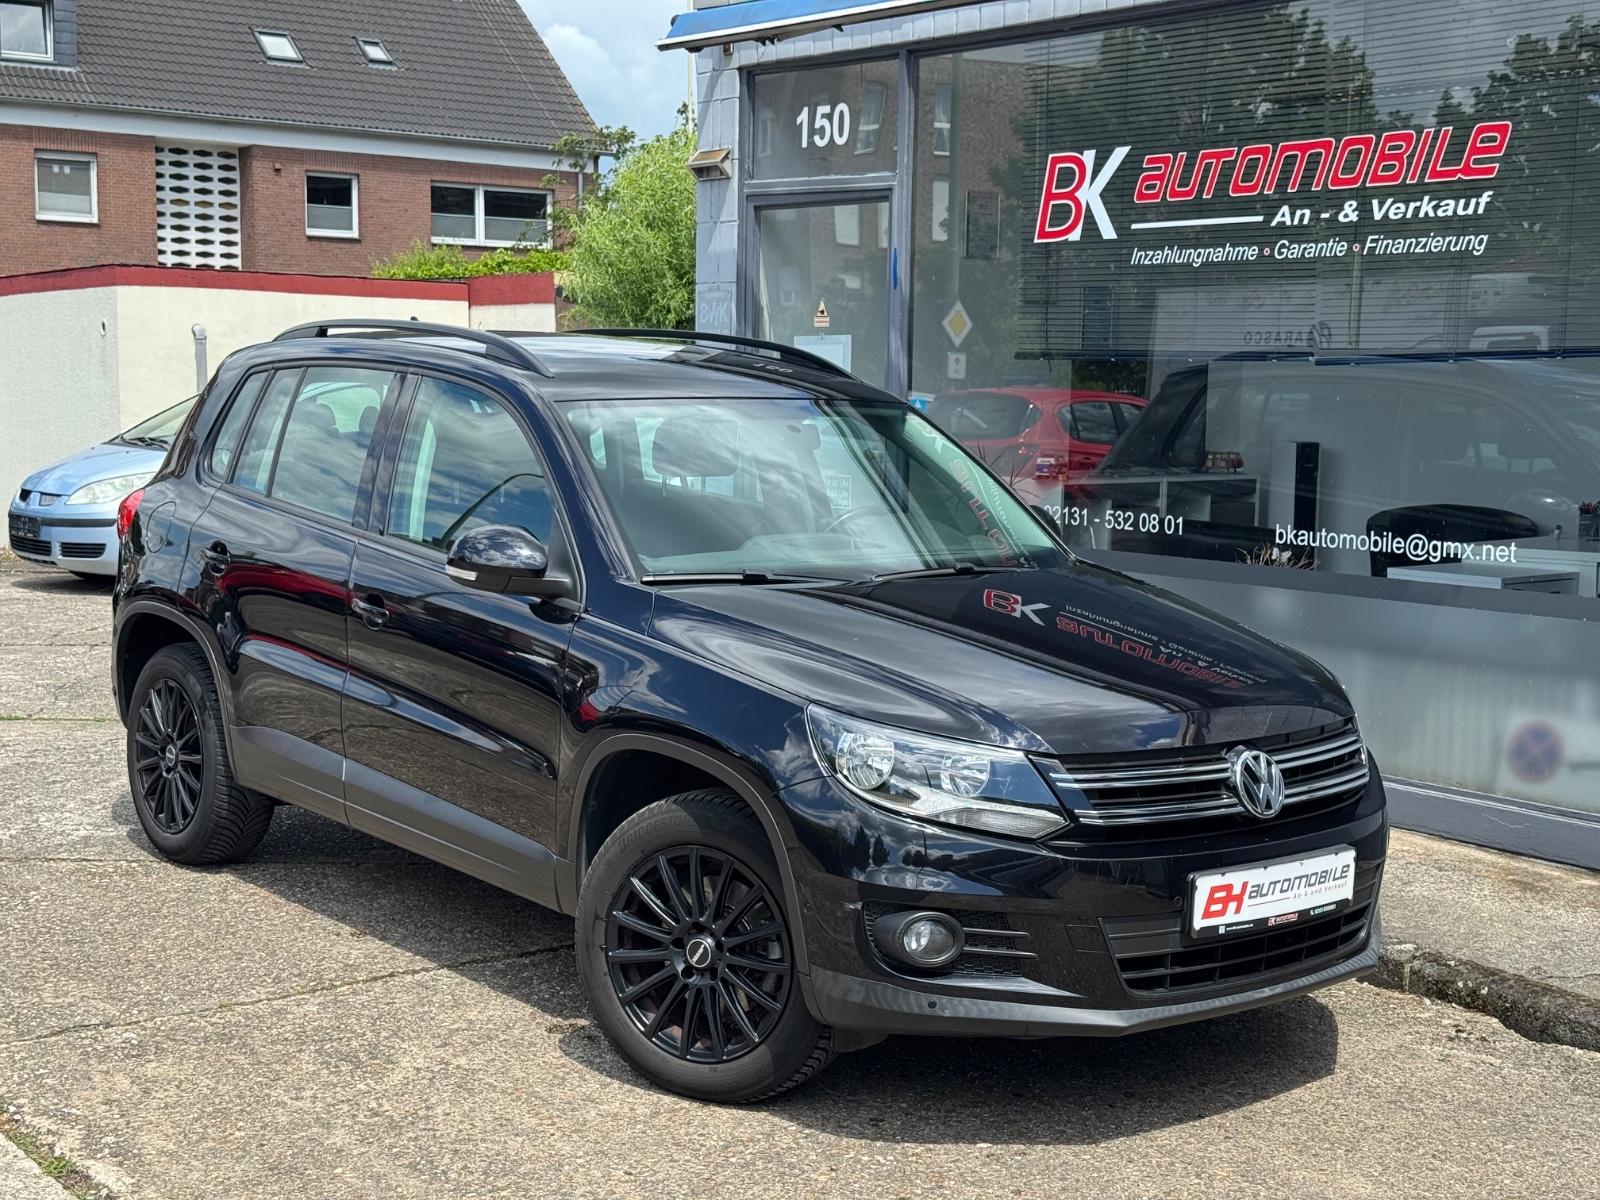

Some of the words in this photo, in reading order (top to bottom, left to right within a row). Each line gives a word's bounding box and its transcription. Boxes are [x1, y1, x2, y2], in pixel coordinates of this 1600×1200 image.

[796, 102, 850, 149] 150
[1033, 145, 1132, 243] BK
[1270, 205, 1311, 227] An
[1338, 200, 1359, 223] &
[1371, 191, 1493, 221] Verkauf
[1130, 243, 1259, 267] Inzahlungnahme
[1274, 236, 1348, 260] Garantie
[1363, 232, 1488, 256] Finanzierung
[1105, 510, 1134, 531] 532
[1139, 513, 1159, 533] 08
[1165, 515, 1183, 536] 01
[1275, 524, 1517, 564] bkautomobile@gmx.net
